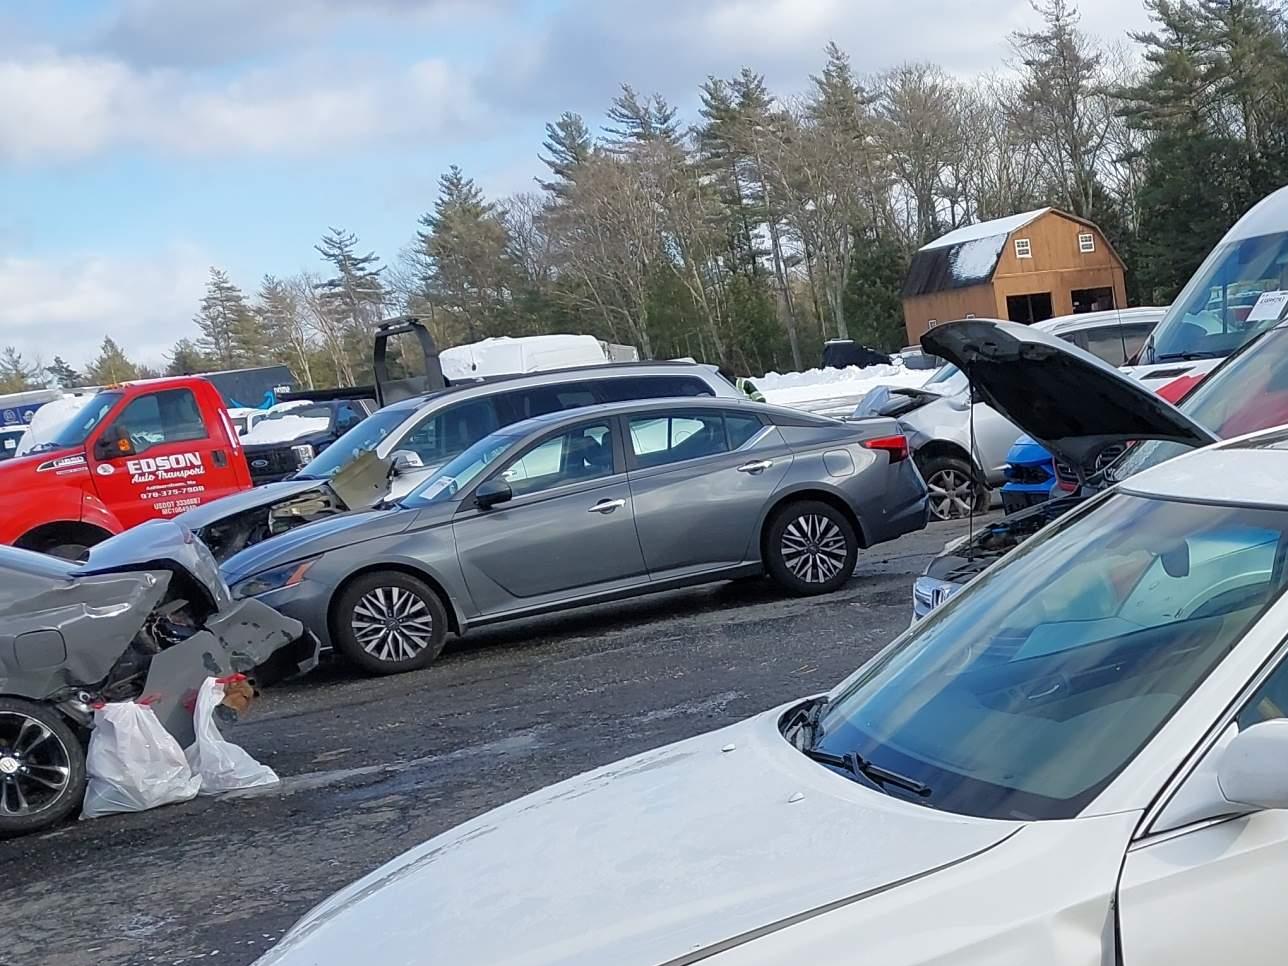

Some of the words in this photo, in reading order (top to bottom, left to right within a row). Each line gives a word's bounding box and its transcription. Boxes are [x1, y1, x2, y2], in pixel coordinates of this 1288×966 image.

[126, 451, 202, 474] EDSON
[131, 472, 156, 484] Auto
[156, 465, 206, 480] Transport
